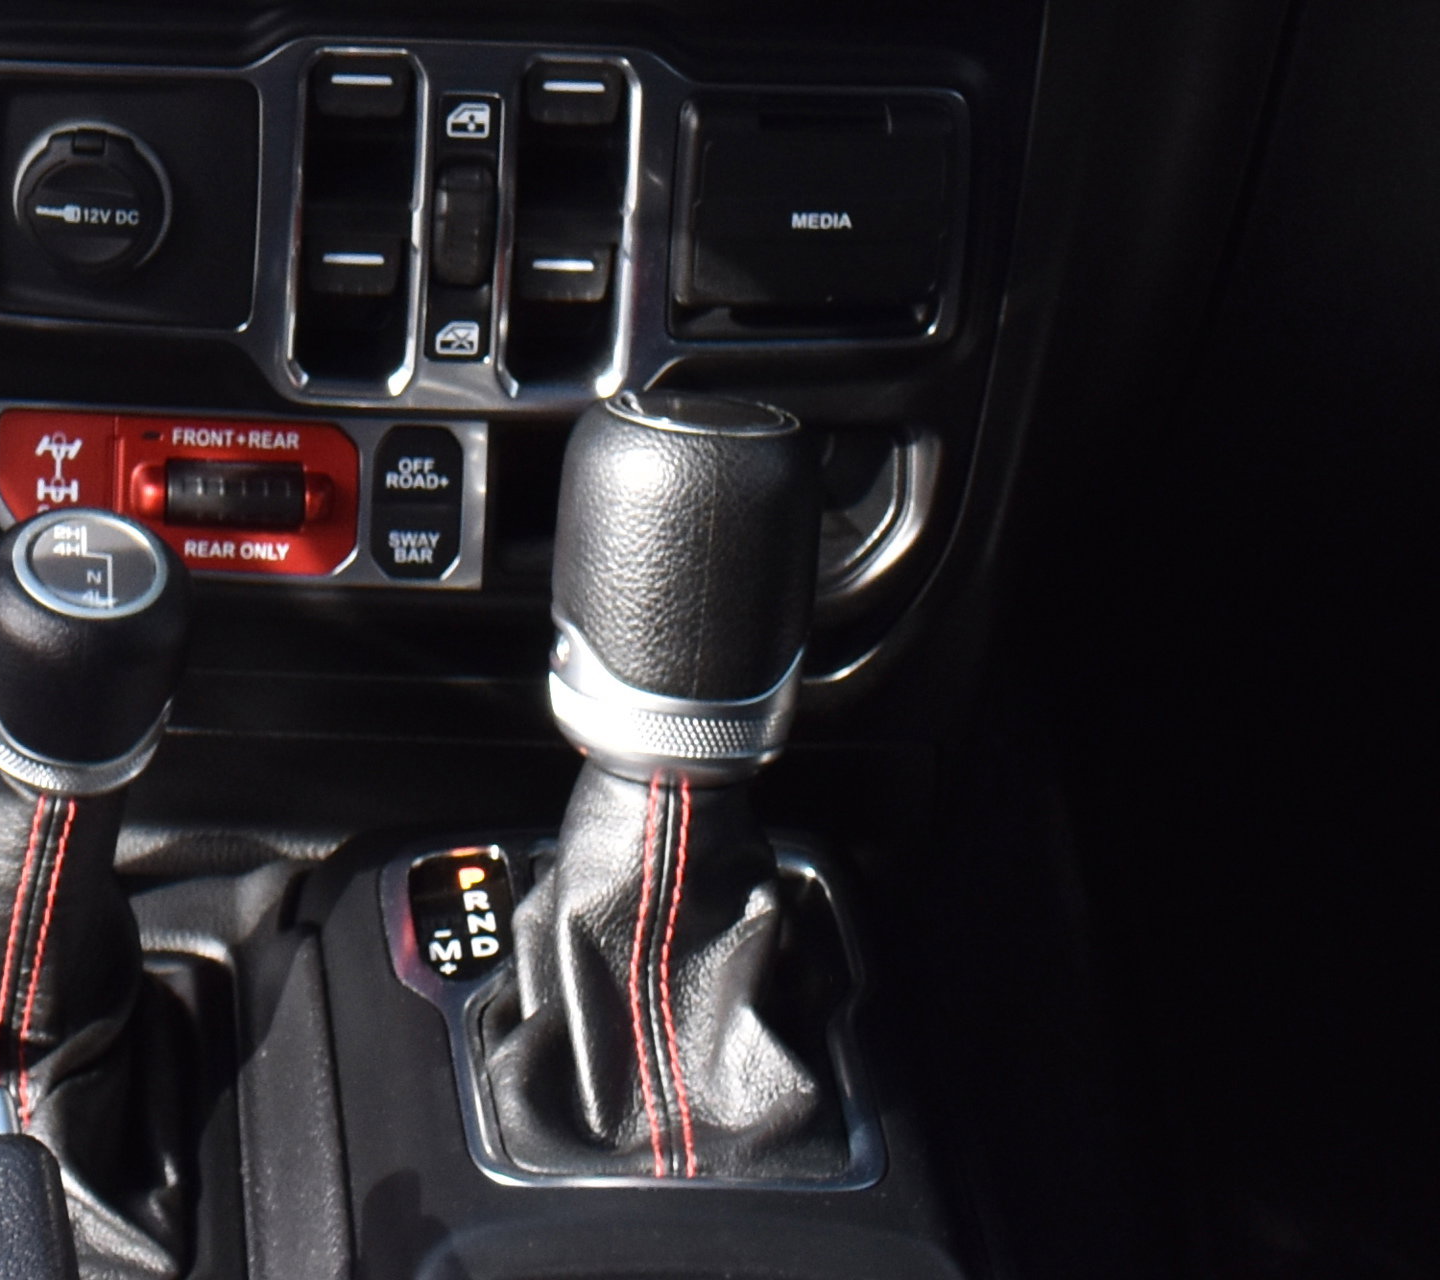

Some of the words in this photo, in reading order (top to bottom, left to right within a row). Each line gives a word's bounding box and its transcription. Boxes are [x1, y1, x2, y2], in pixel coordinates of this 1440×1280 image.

[83, 207, 111, 224] 12V
[115, 209, 140, 226] DC
[790, 211, 853, 230] MEDIA
[171, 428, 300, 450] FRONT+REAR
[397, 458, 435, 474] OFF
[52, 541, 80, 557] 4H
[387, 531, 440, 548] SWAY
[184, 541, 236, 559] REAR
[239, 543, 290, 561] ONLY
[394, 547, 434, 564] BAR
[86, 569, 102, 585] N
[81, 589, 106, 605] 4L
[458, 866, 486, 890] P
[463, 890, 490, 912] R
[467, 912, 497, 934] N
[428, 939, 463, 961] M
[471, 935, 500, 958] D
